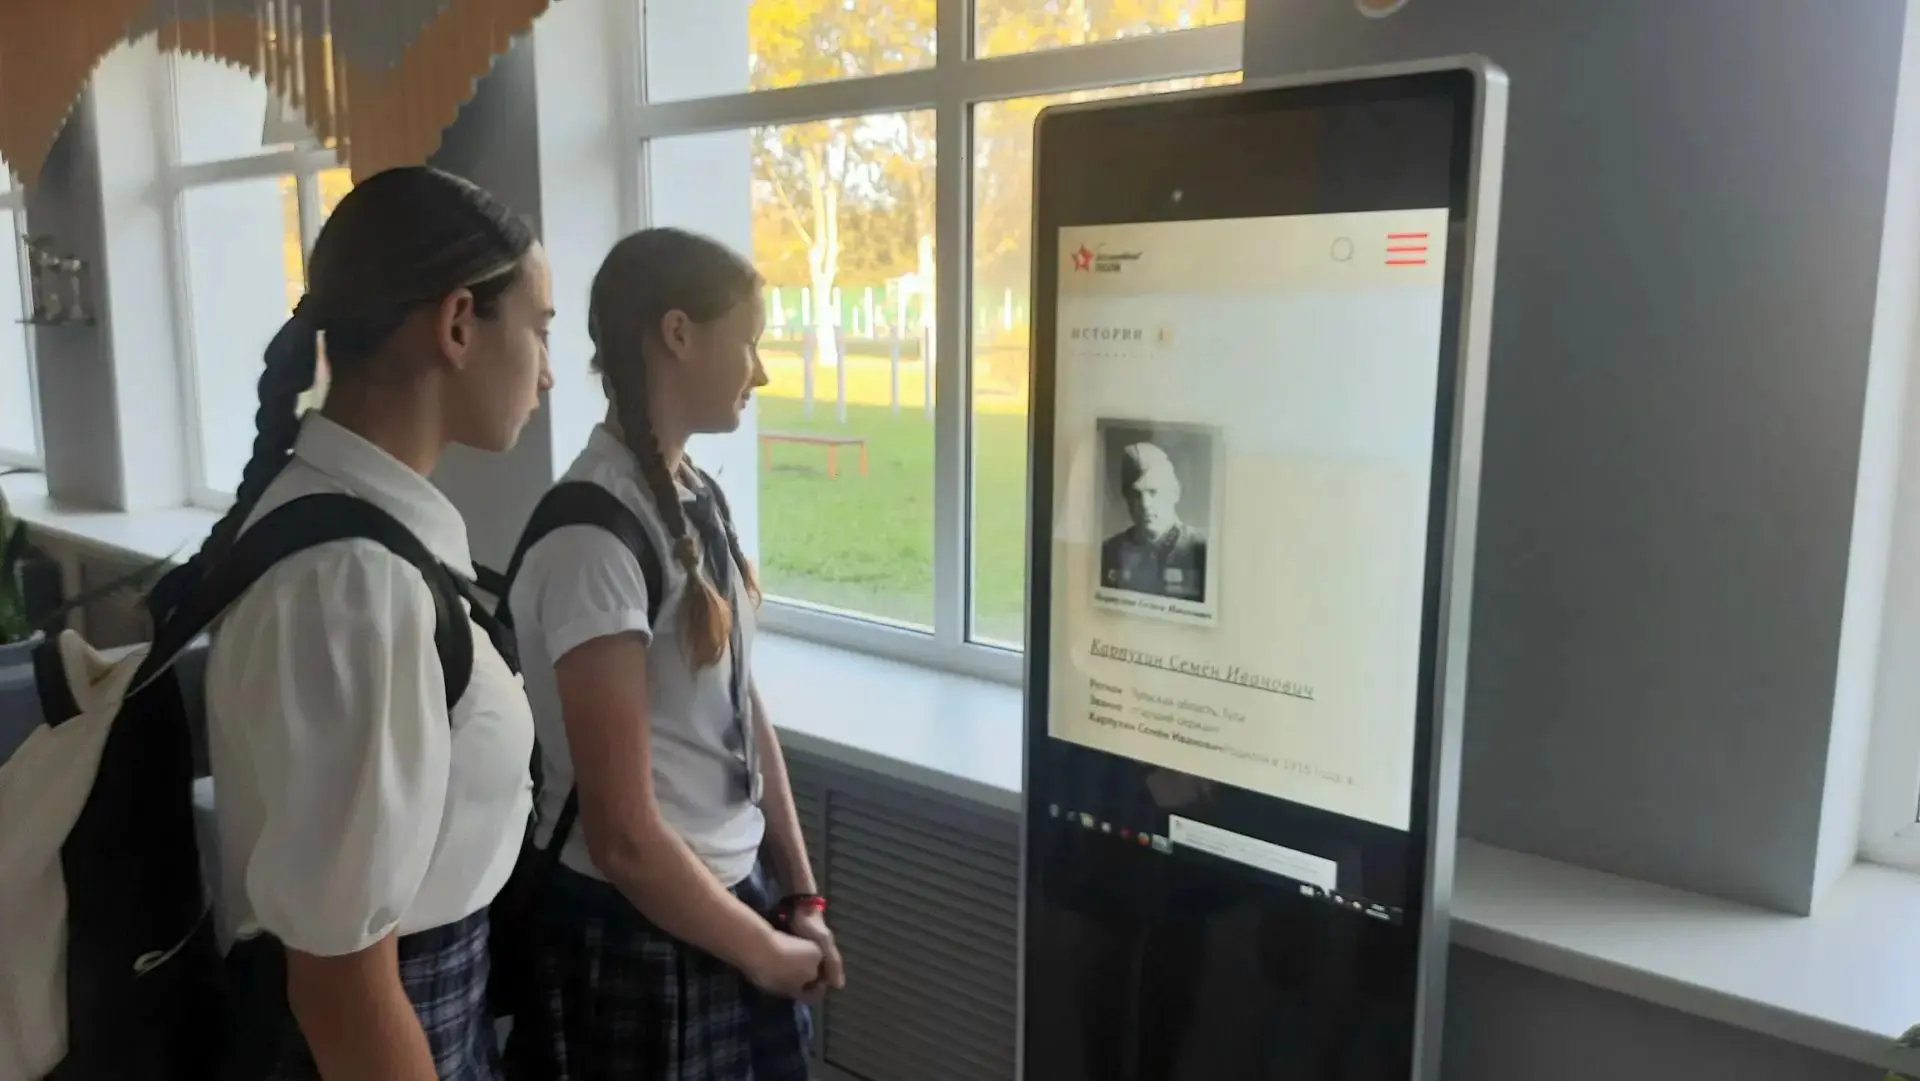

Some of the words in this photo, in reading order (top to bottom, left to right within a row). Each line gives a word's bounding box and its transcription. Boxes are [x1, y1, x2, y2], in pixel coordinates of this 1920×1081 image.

[1071, 327, 1143, 341] ИСТОРИИ
[1089, 637, 1163, 668] Карпухин
[1168, 654, 1220, 677] Семён
[1226, 664, 1314, 698] Иванович
[1088, 711, 1135, 731] Карпухин
